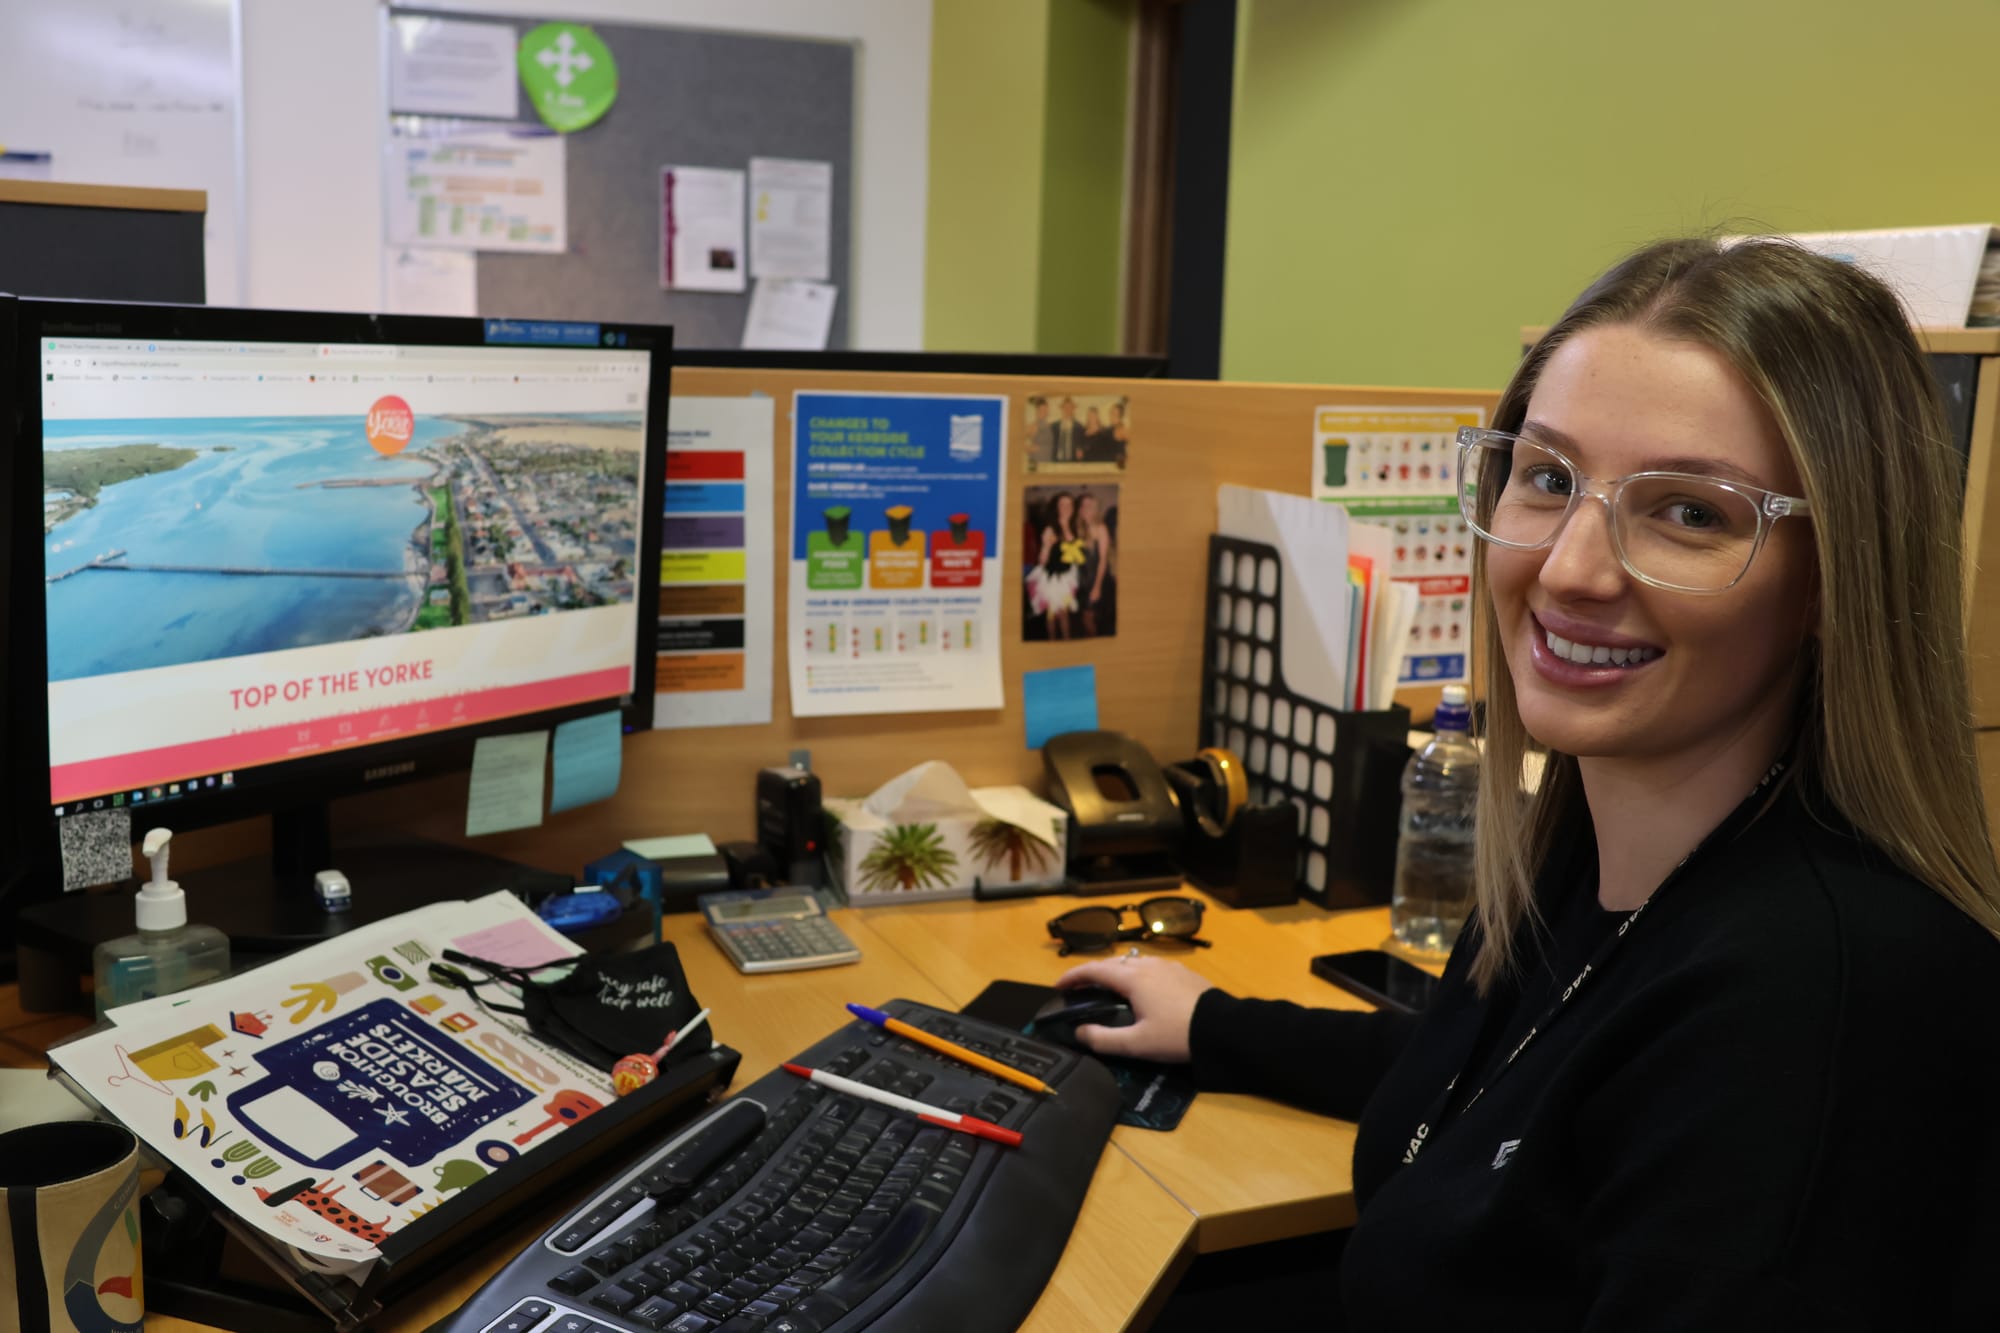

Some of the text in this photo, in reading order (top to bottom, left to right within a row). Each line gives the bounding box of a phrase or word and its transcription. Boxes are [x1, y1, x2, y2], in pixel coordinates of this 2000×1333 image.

[809, 417, 890, 430] CHANGES TO
[809, 432, 909, 444] YOUR KERBSIDE
[809, 445, 925, 459] COLLECTION CYCLE
[230, 660, 433, 710] TOP OF THE YORKE
[365, 761, 416, 781] SAMSUNG
[635, 974, 669, 993] safe
[636, 990, 674, 1008] well
[345, 1033, 467, 1111] SEASIDE
[369, 1024, 489, 1102] MARKETS
[326, 1043, 449, 1124] BROUGHTON
[1402, 1122, 1429, 1165] VAC
